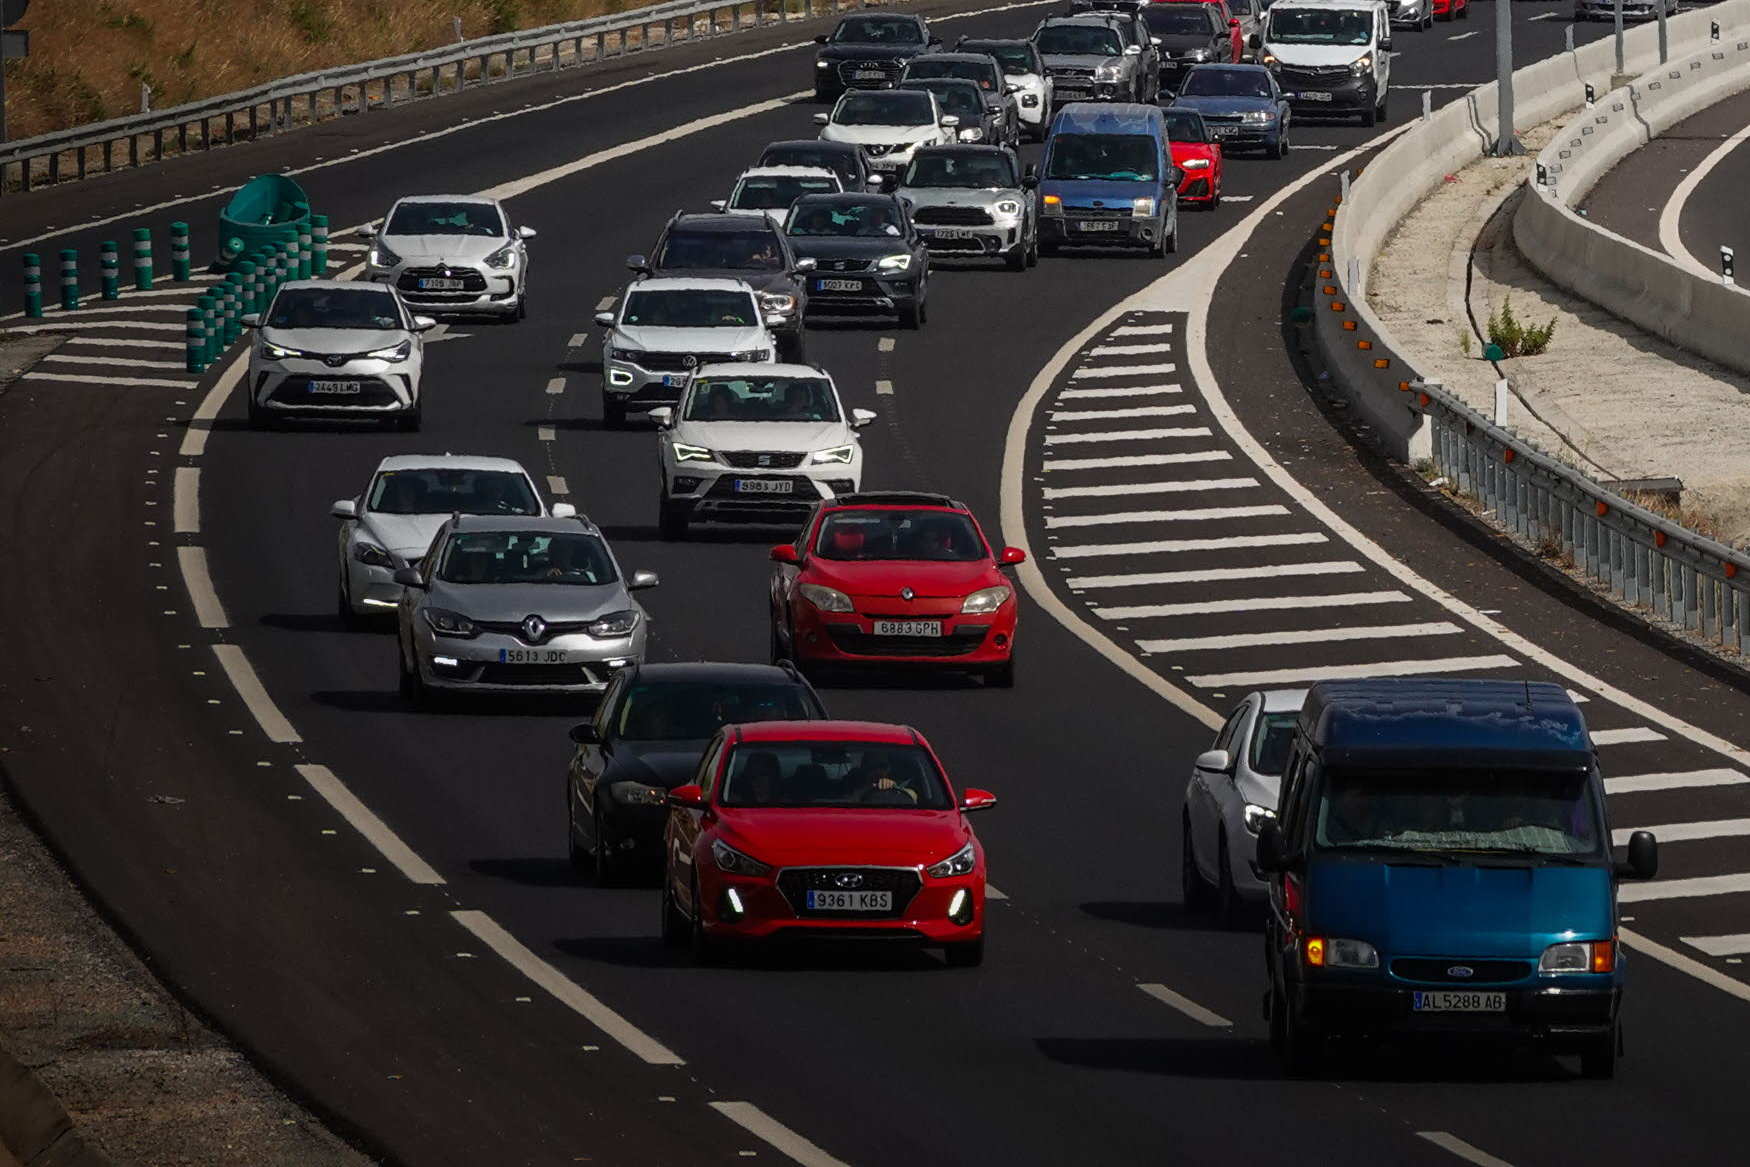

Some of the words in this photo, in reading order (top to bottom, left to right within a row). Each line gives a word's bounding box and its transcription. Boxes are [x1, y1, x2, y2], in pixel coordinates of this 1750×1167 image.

[915, 622, 939, 635] GPH
[543, 650, 567, 663] JDC
[817, 893, 853, 908] 9361
[860, 893, 888, 908] KBS
[1484, 994, 1502, 1009] AB
